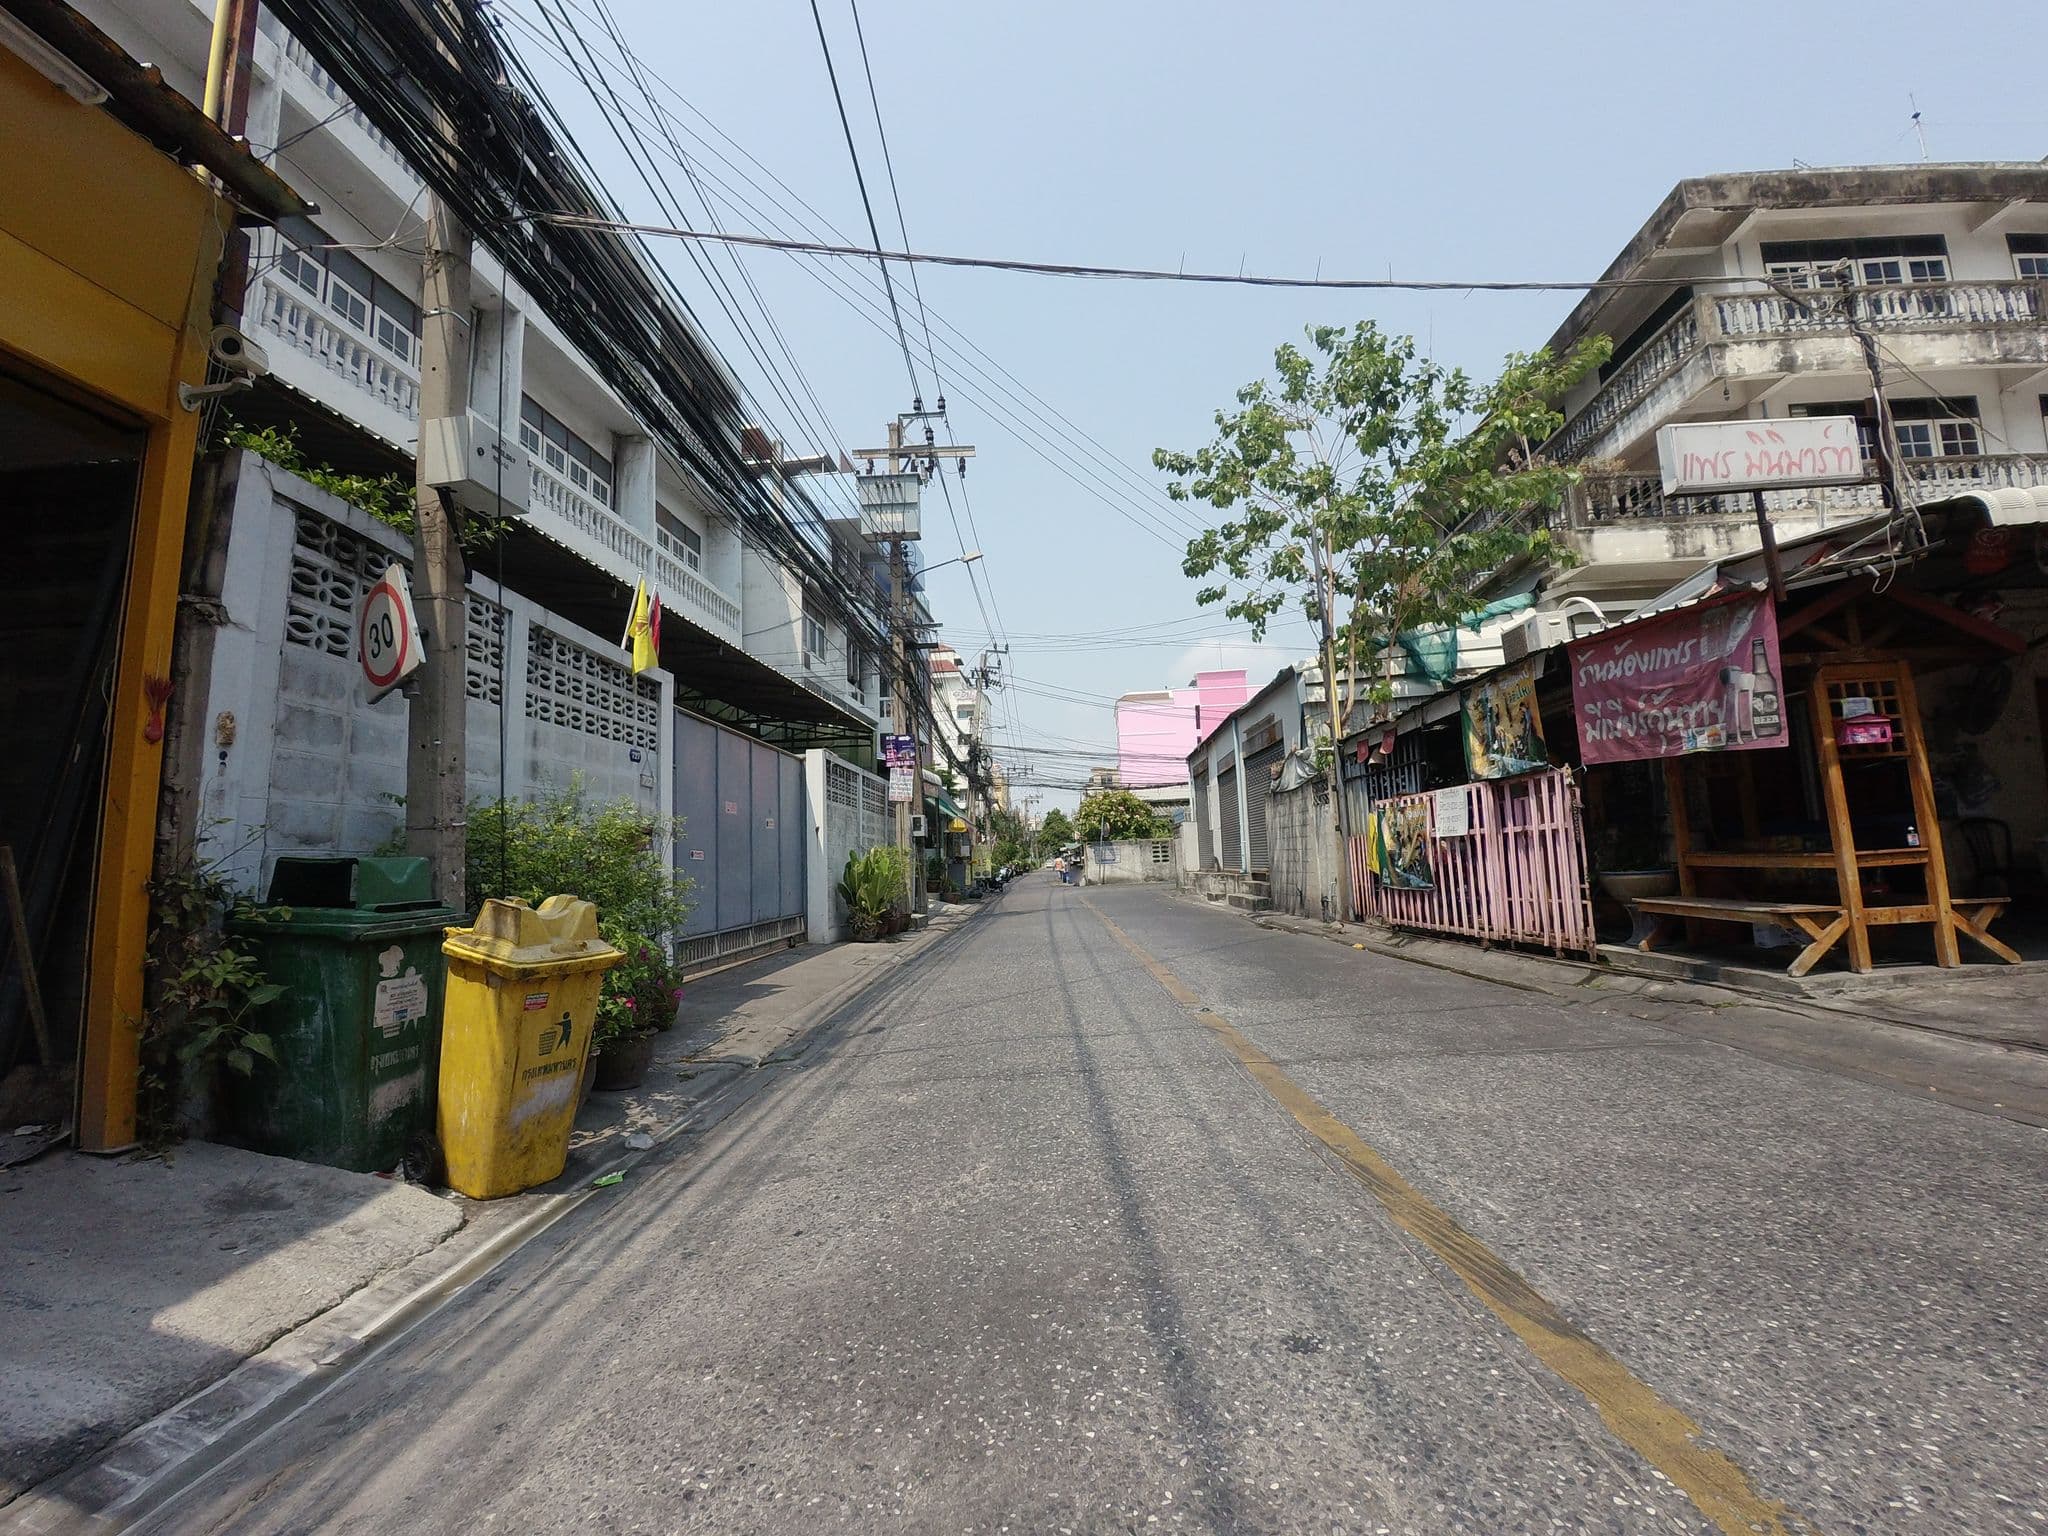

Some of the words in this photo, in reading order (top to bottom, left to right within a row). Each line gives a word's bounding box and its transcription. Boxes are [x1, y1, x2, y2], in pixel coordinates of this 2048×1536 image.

[1683, 450, 1736, 481] แพร
[369, 612, 394, 659] 30
[1577, 639, 1698, 687] ร้านน้องแพร
